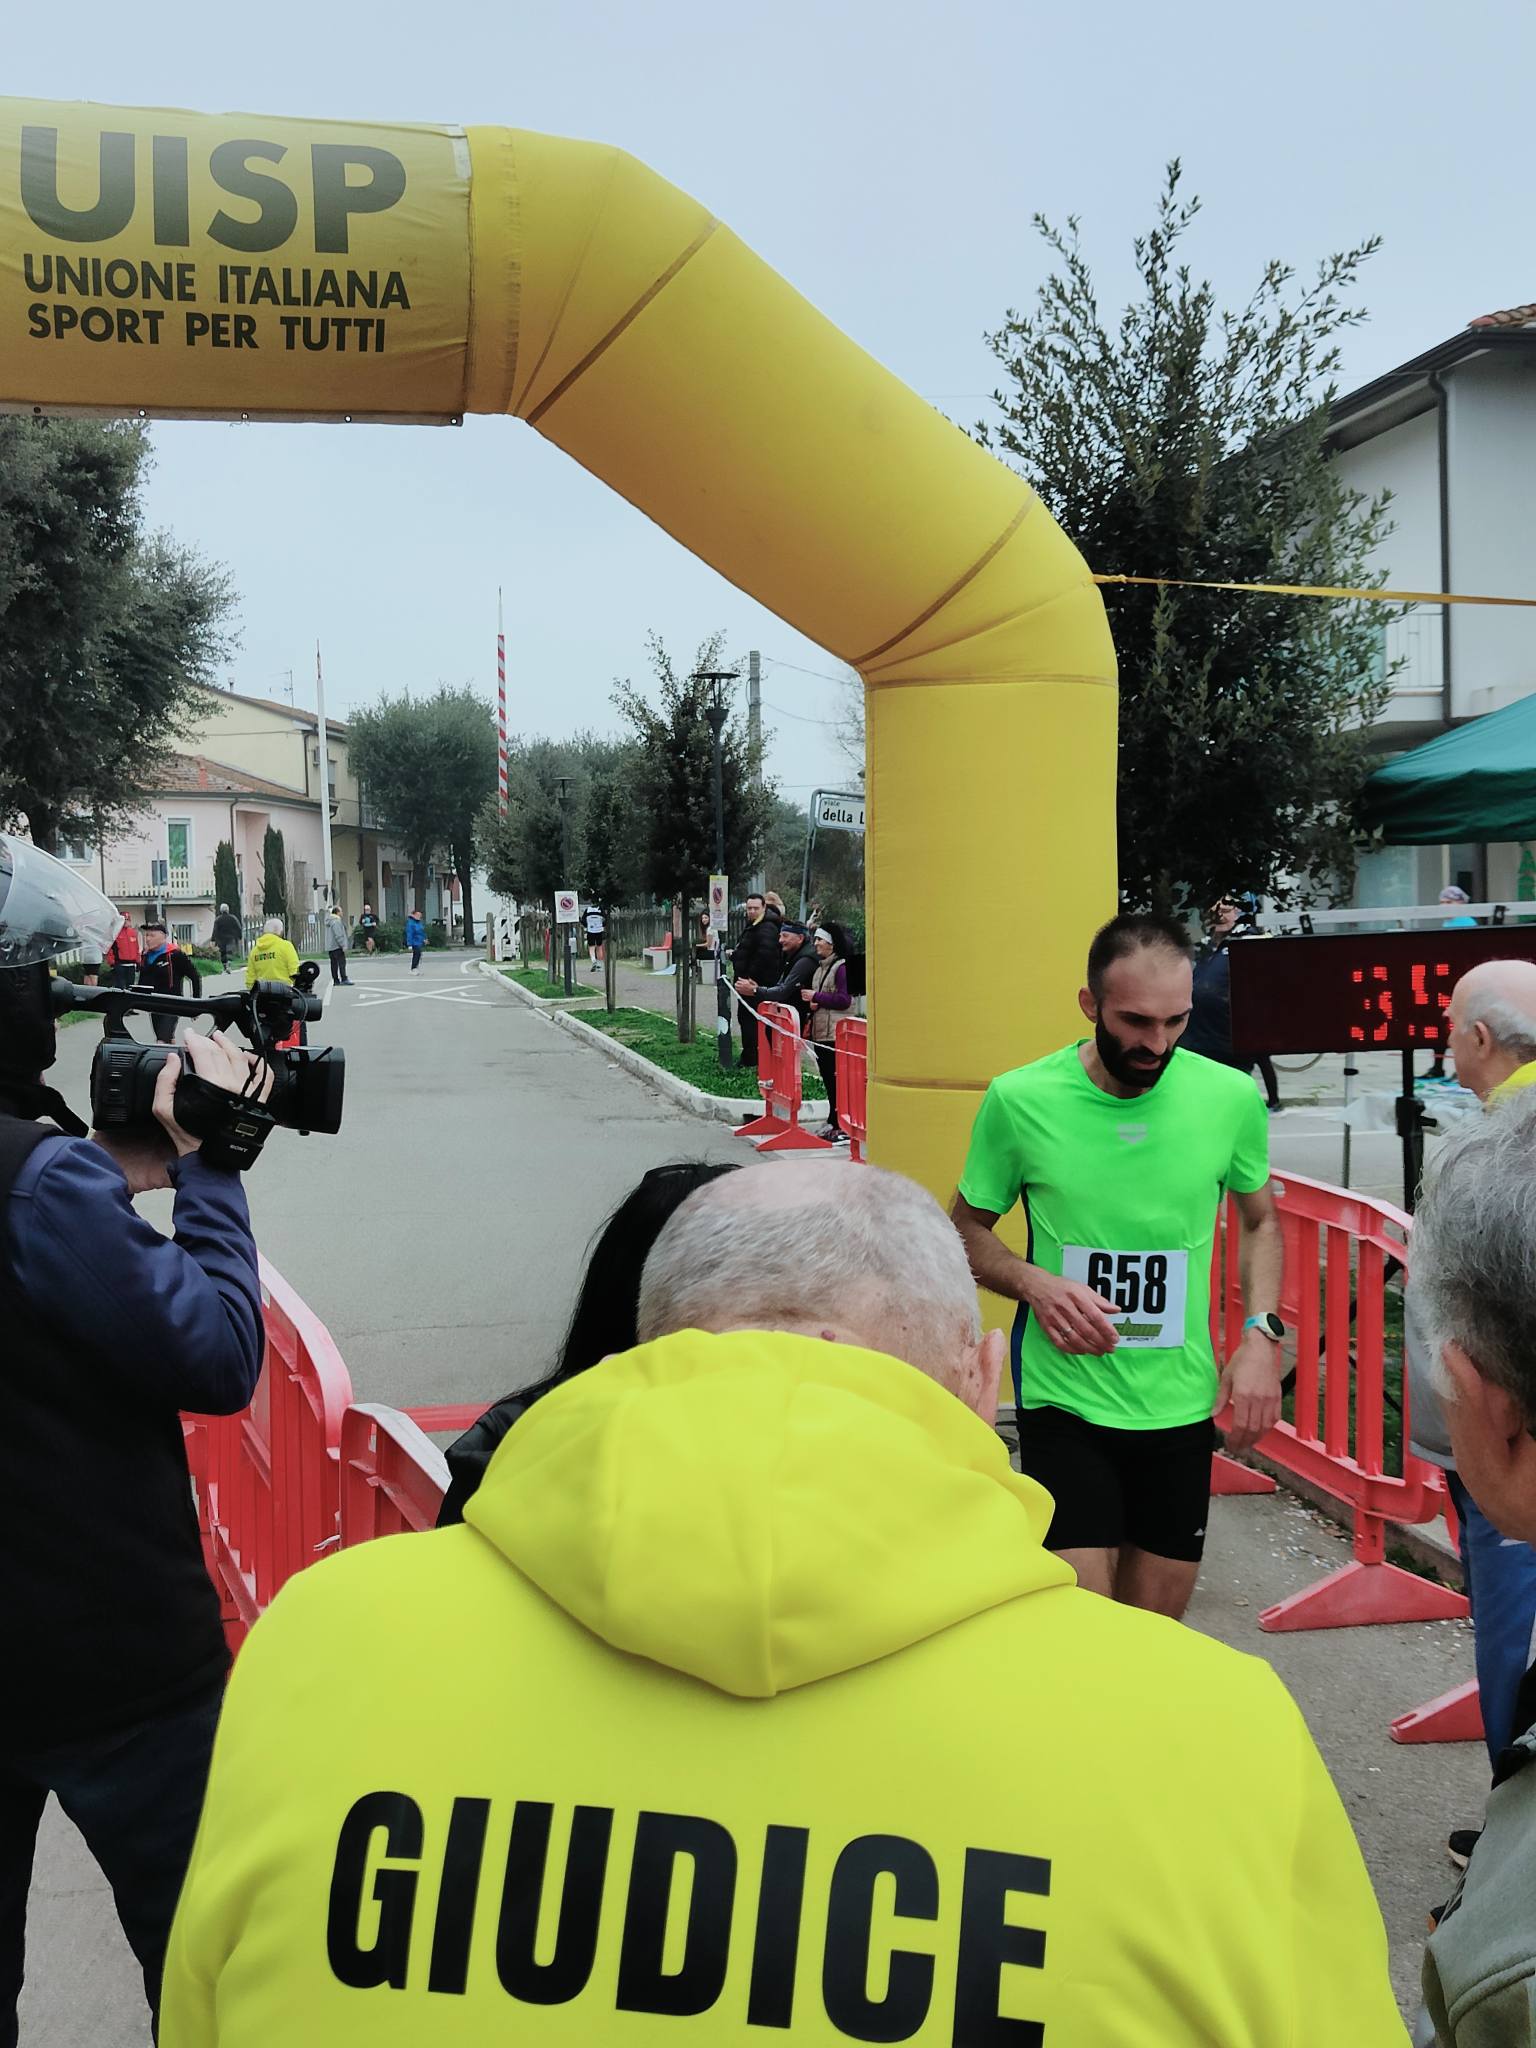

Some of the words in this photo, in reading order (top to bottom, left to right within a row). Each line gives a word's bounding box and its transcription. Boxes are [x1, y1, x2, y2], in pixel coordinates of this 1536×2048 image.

[20, 125, 407, 254] UISP
[23, 253, 197, 302] UNIONE
[218, 264, 411, 310] ITALIANA
[28, 303, 165, 345] SPORT
[185, 311, 259, 349] PER
[280, 316, 386, 353] TUTTI
[822, 808, 853, 823] della
[1087, 1252, 1168, 1314] 658
[326, 1790, 1052, 2048] GIUDICE
